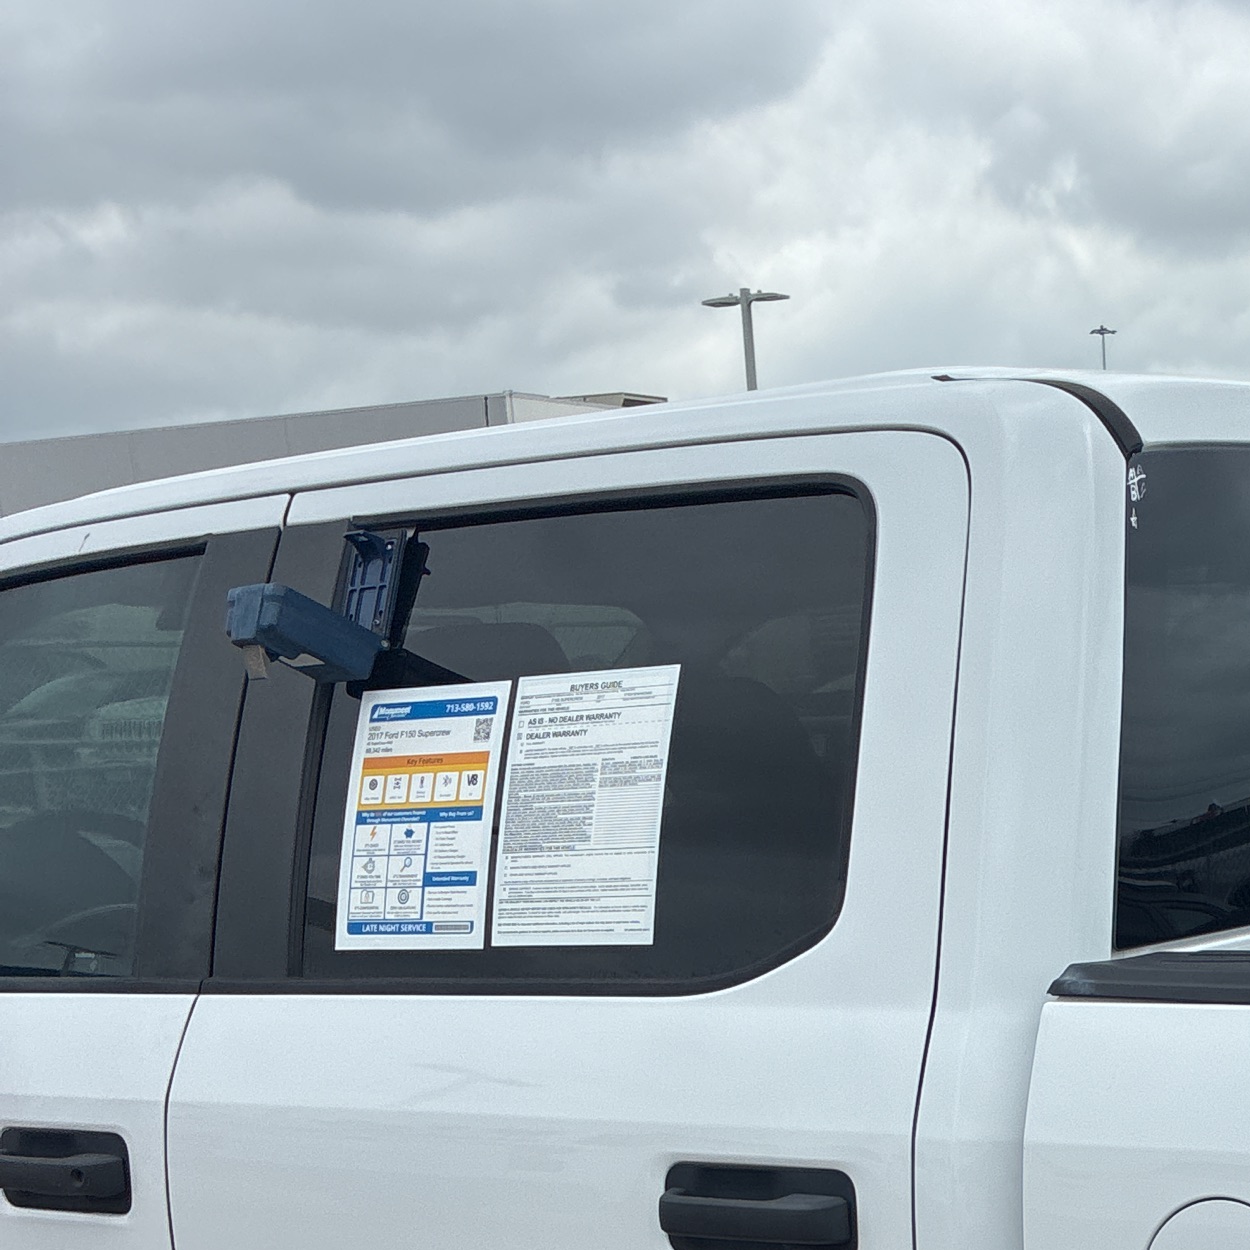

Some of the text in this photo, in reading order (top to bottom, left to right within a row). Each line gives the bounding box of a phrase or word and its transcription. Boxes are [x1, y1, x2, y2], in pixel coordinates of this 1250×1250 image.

[570, 680, 623, 692] BUYERS GUIDE
[528, 718, 537, 726] AS
[548, 716, 558, 724] NO
[558, 714, 584, 723] DEALER
[585, 712, 622, 721] WARRANTY
[368, 729, 451, 741] 2017 Ford F150 Supercrew
[526, 729, 589, 740] DEALER WARRANTY
[407, 757, 444, 766] Key Features
[467, 773, 478, 786] V8
[361, 924, 378, 932] LATE
[378, 924, 399, 932] NIGHT
[400, 923, 427, 932] SERVICE
